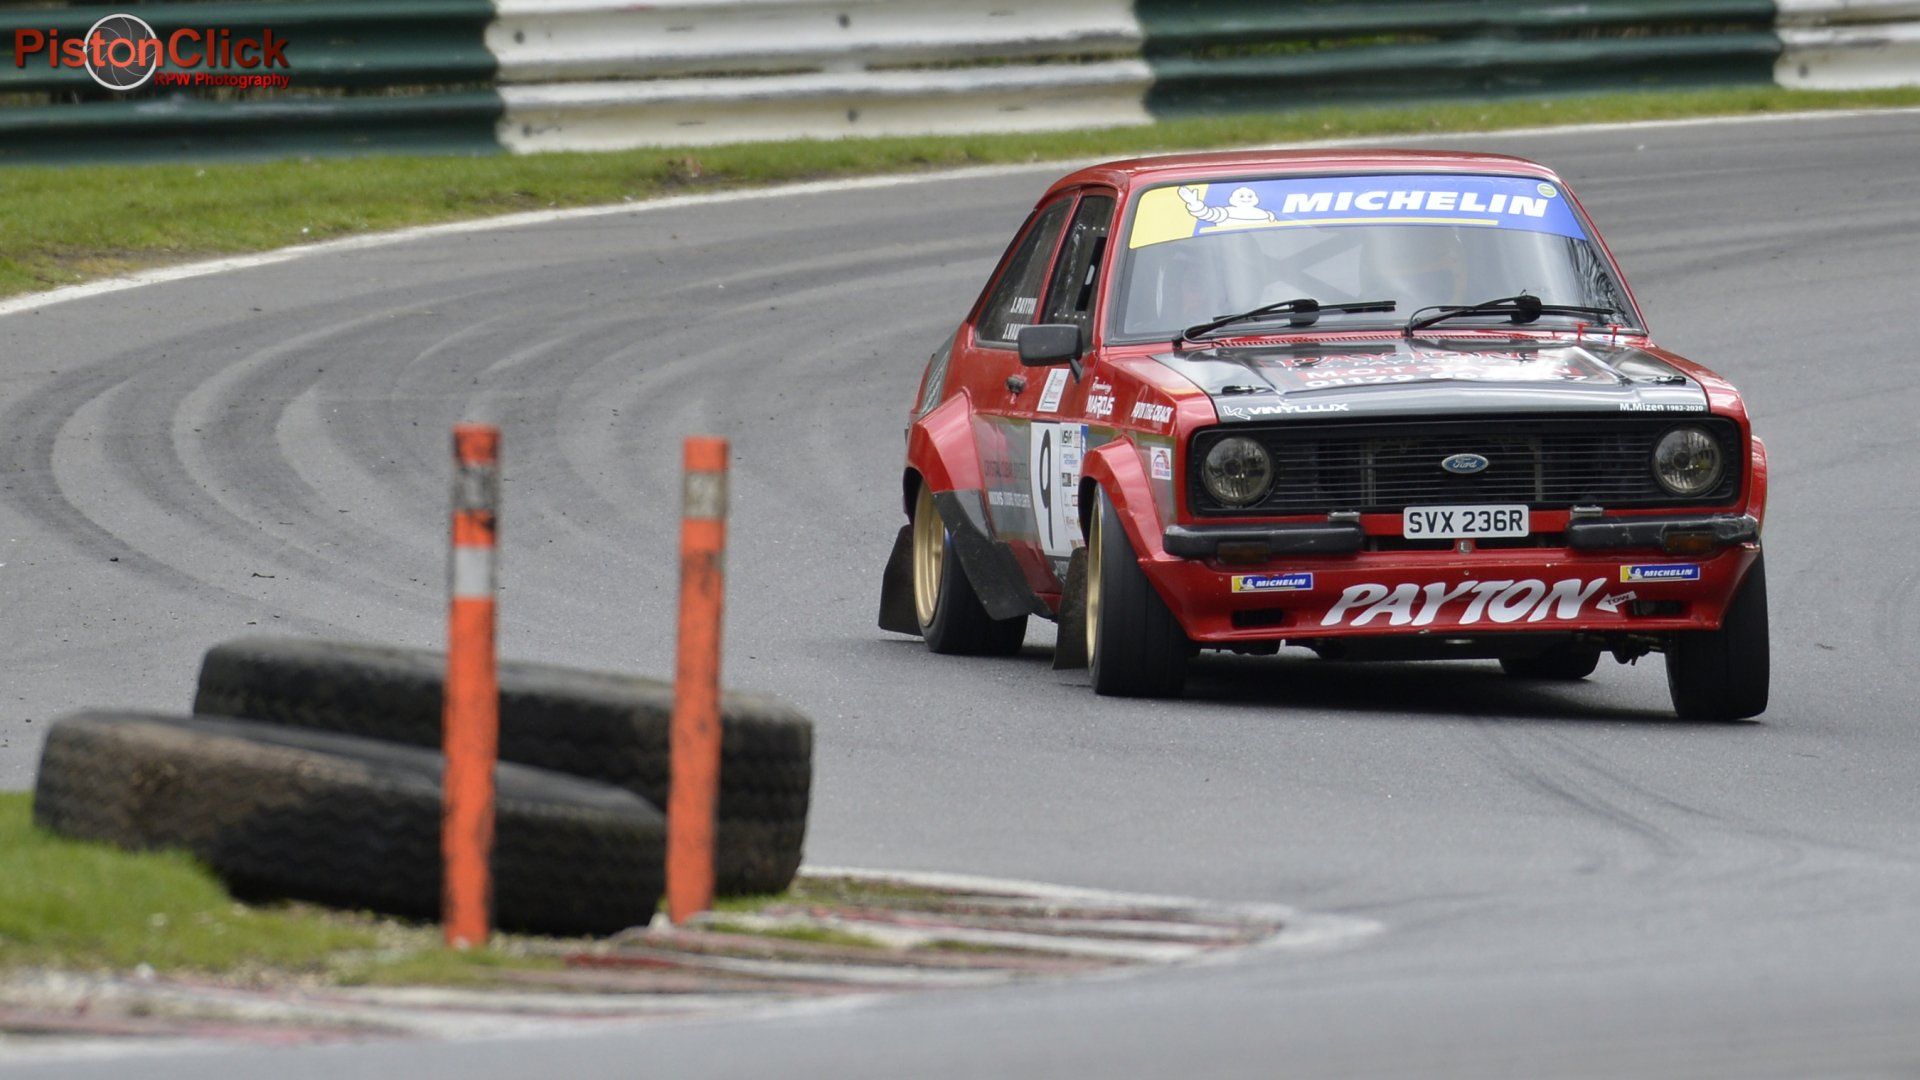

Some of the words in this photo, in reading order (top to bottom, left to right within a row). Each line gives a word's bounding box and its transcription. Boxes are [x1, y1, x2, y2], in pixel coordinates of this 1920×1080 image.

[1281, 190, 1548, 218] MICHELIN
[1304, 374, 1415, 387] 01179
[1248, 402, 1350, 415] VINYLLUX
[1619, 402, 1664, 412] M.Mizen
[1451, 458, 1478, 469] Ford
[1039, 428, 1054, 550] 9
[1408, 511, 1455, 534] SVX
[1461, 509, 1524, 532] 236R
[1643, 569, 1694, 577] MICHELIN
[1255, 578, 1307, 587] MICHELIN
[1320, 577, 1608, 626] PAYTON
[1606, 593, 1630, 606] TOW
